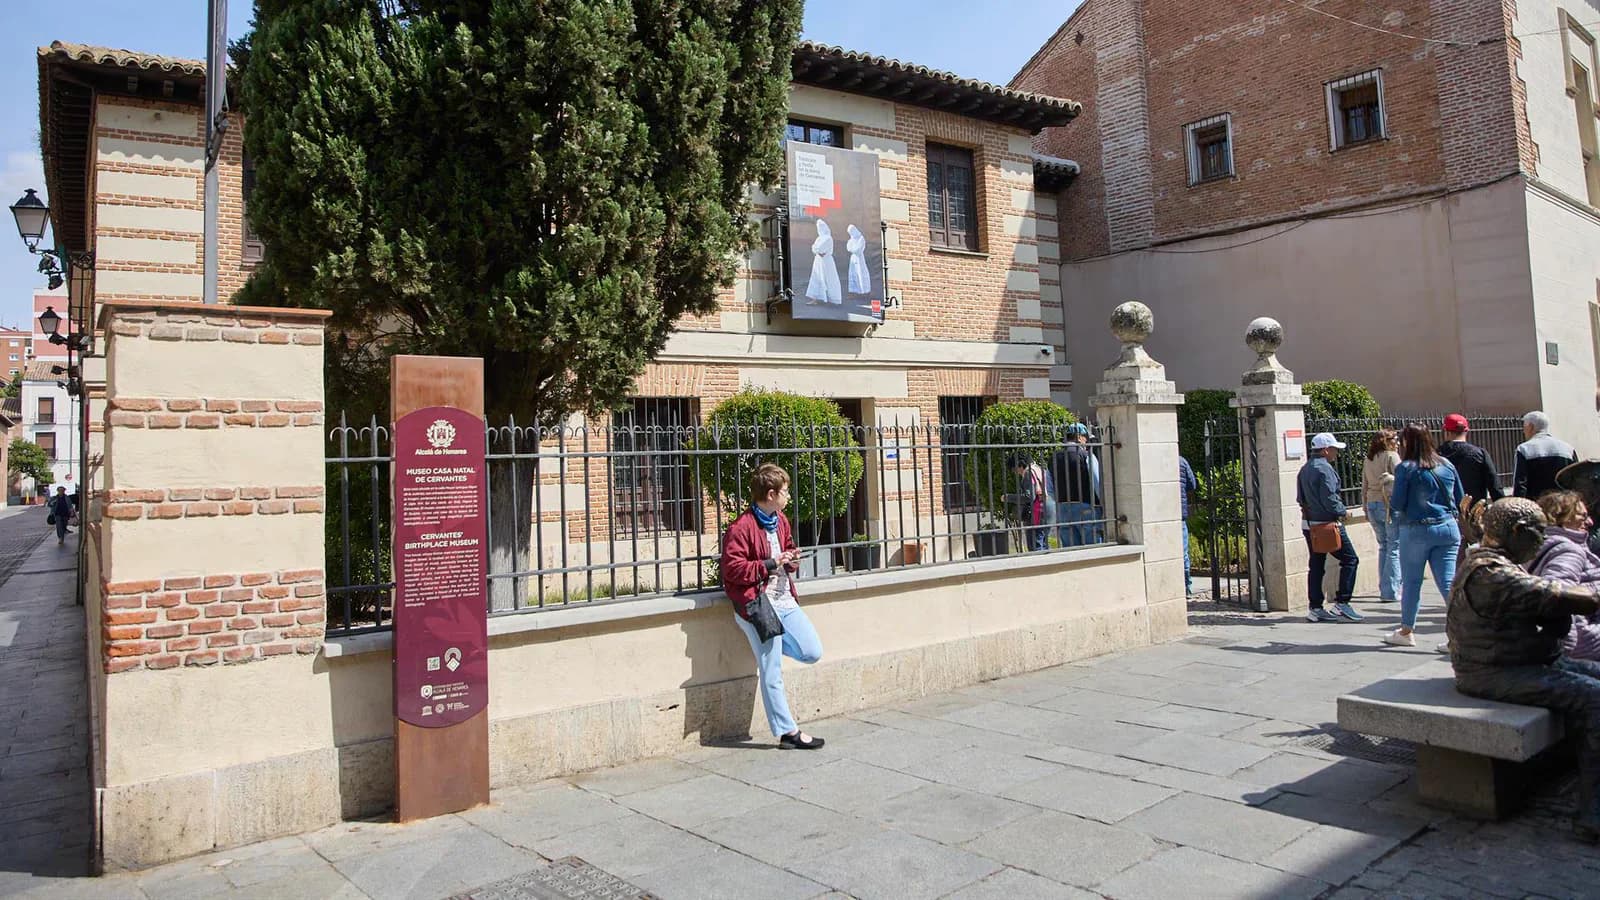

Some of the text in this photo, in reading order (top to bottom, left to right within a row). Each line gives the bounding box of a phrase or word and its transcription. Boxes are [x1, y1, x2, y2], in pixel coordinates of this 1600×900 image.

[415, 448, 434, 456] Alcalá
[406, 467, 432, 475] MUSEO
[453, 466, 475, 474] NATAL
[415, 475, 467, 484] DE CERVANTES
[404, 538, 479, 550] BIRTHPLACE MUSEUM
